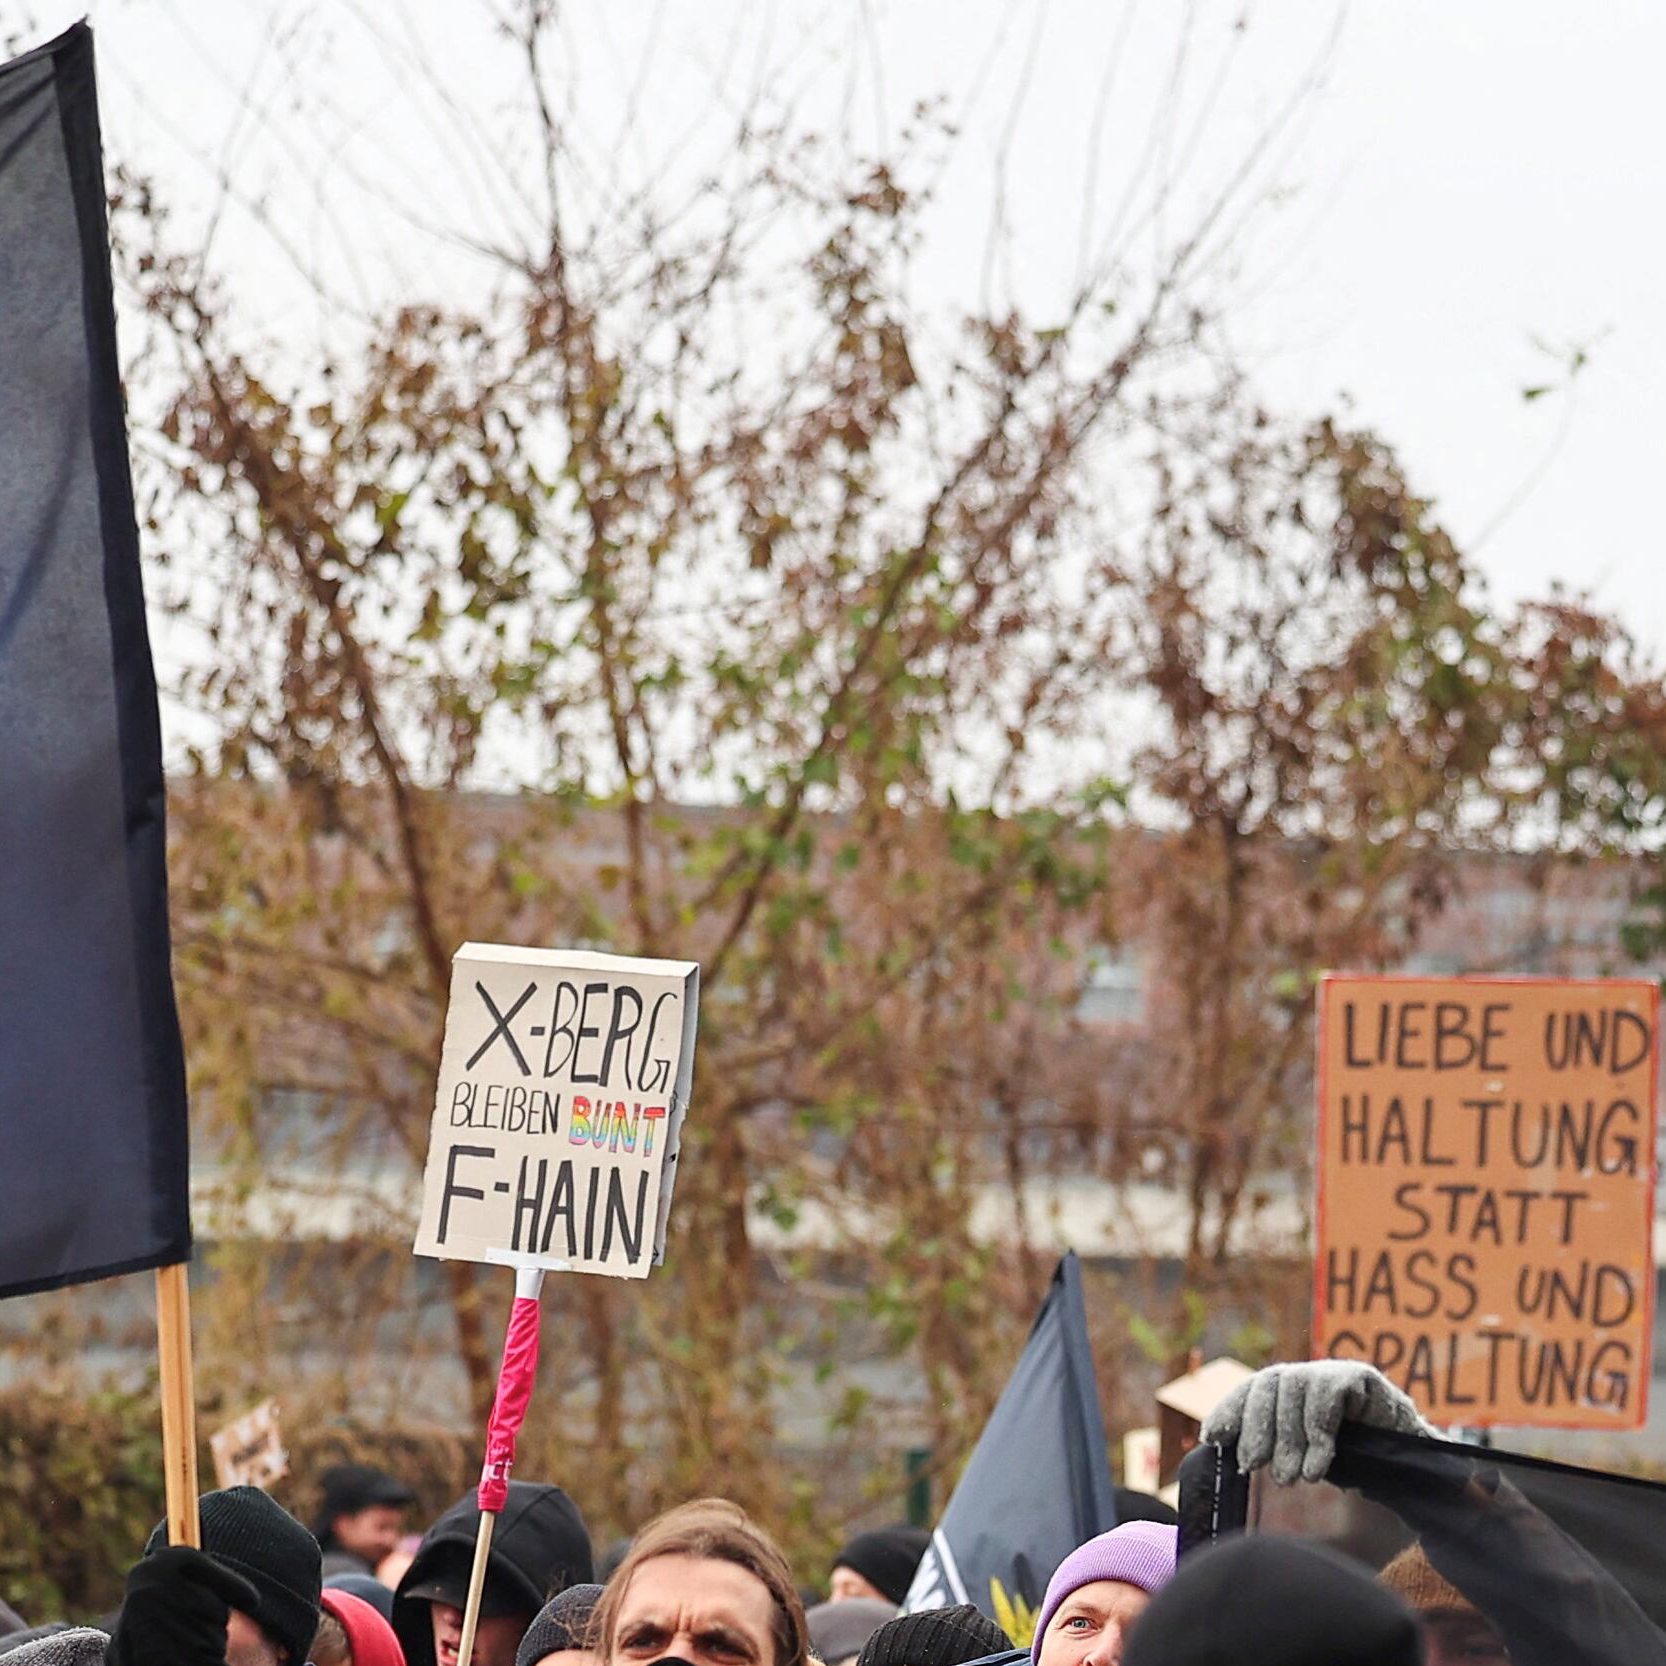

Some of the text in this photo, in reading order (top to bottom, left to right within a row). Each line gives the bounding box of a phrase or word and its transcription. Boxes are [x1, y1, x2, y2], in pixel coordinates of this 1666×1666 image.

[465, 980, 678, 1094] X-BERG
[1343, 1001, 1650, 1075] LIEBE UND
[449, 1081, 666, 1158] BLEIBEN BUNT
[1341, 1095, 1639, 1177] HALTUNG
[436, 1144, 649, 1265] F-HAIN
[1388, 1182, 1590, 1245] STATT
[1325, 1248, 1634, 1329] HASS UND
